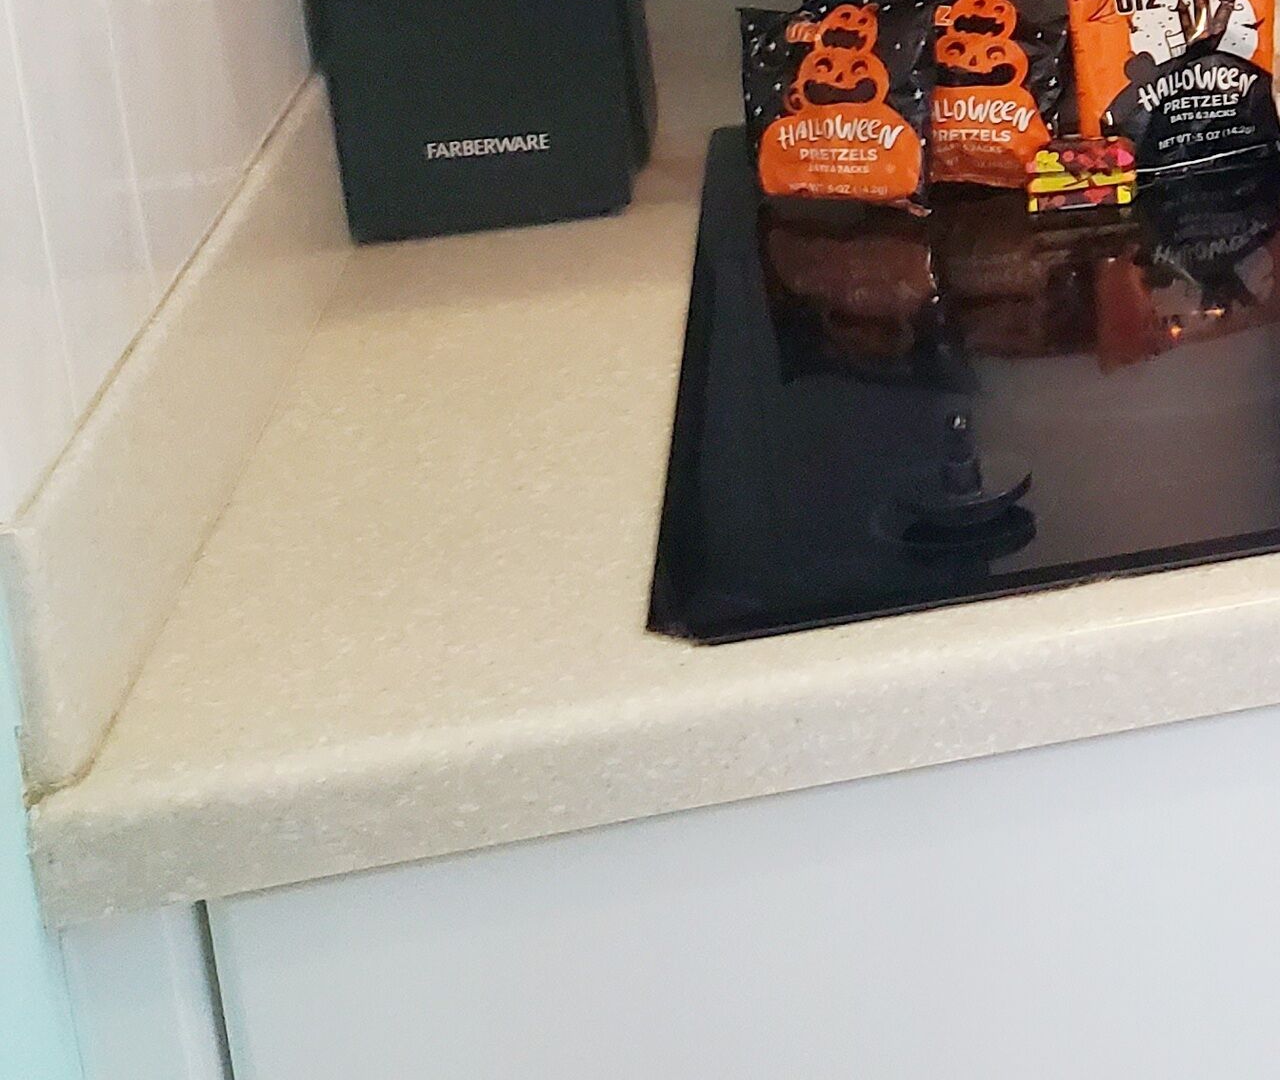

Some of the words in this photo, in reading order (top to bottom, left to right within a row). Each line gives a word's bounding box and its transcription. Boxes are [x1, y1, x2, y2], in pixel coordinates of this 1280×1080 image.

[932, 95, 1036, 132] LLOWEEN
[1163, 93, 1240, 115] PRETZELS
[1170, 112, 1194, 123] BATS
[1202, 108, 1237, 119] JACKS
[426, 133, 550, 159] FARBERWARE
[1158, 136, 1175, 150] NET
[1205, 130, 1221, 141] OZ
[799, 148, 878, 162] PRETZELS
